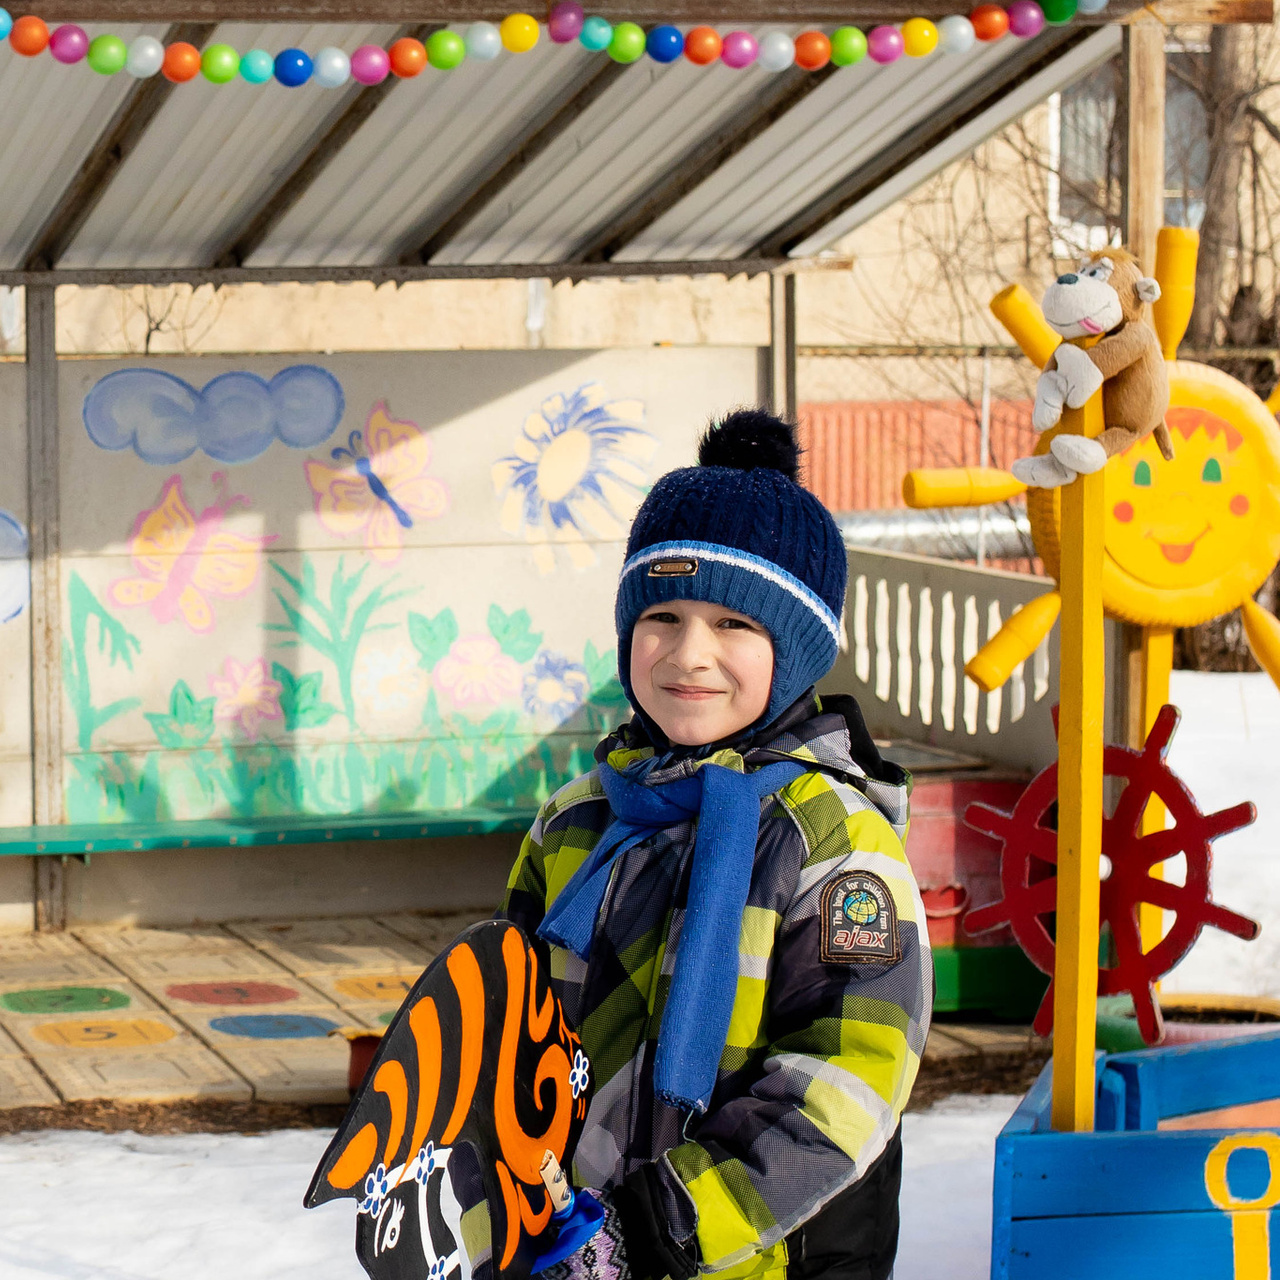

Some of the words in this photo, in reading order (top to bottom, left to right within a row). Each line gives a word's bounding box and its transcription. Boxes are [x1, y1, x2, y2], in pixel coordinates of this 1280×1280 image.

[832, 910, 843, 926] The
[846, 881, 859, 891] for
[863, 881, 886, 908] children
[833, 925, 889, 950] ajax
[80, 1025, 118, 1042] 5
